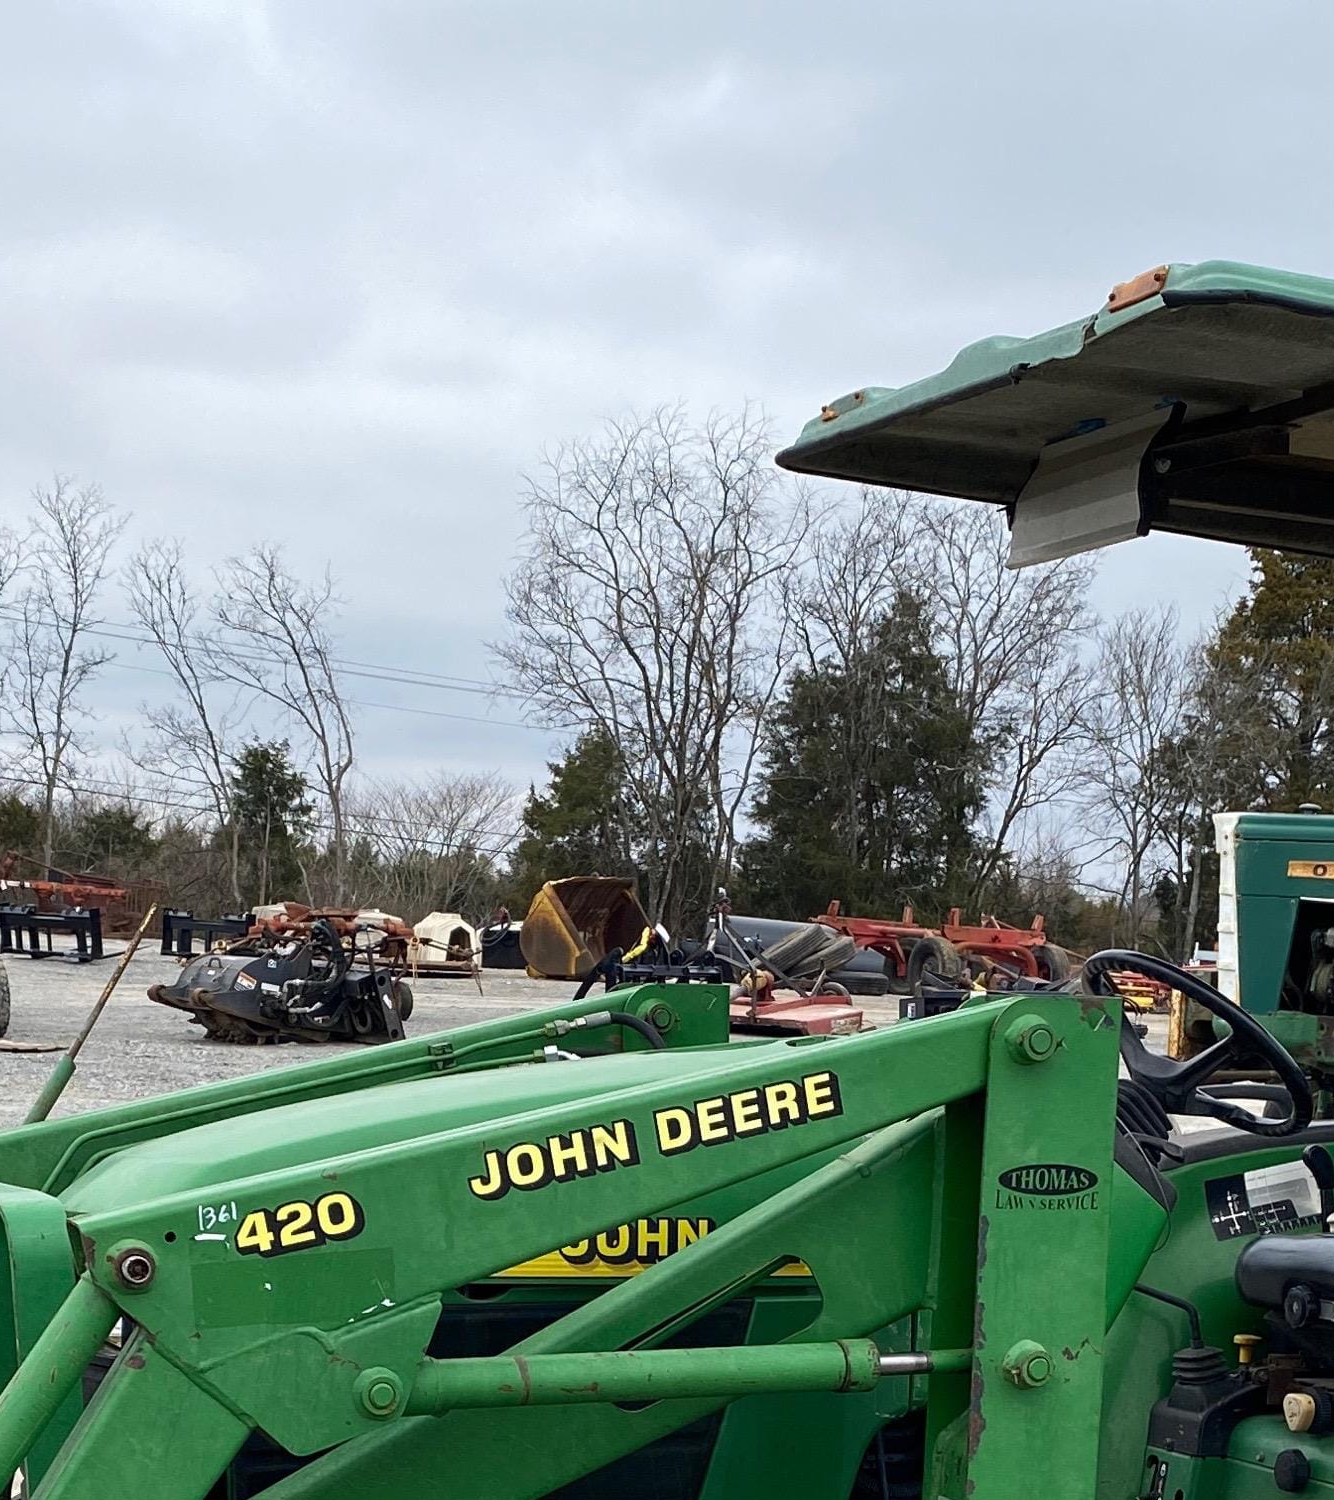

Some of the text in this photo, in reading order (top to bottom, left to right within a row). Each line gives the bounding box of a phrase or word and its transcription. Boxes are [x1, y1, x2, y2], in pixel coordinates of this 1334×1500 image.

[469, 1070, 844, 1200] JOHN DEERE
[1008, 1167, 1090, 1190] THOMAS
[1038, 1190, 1100, 1210] SERVICE
[198, 1201, 237, 1231] 1361
[235, 1191, 365, 1258] 420
